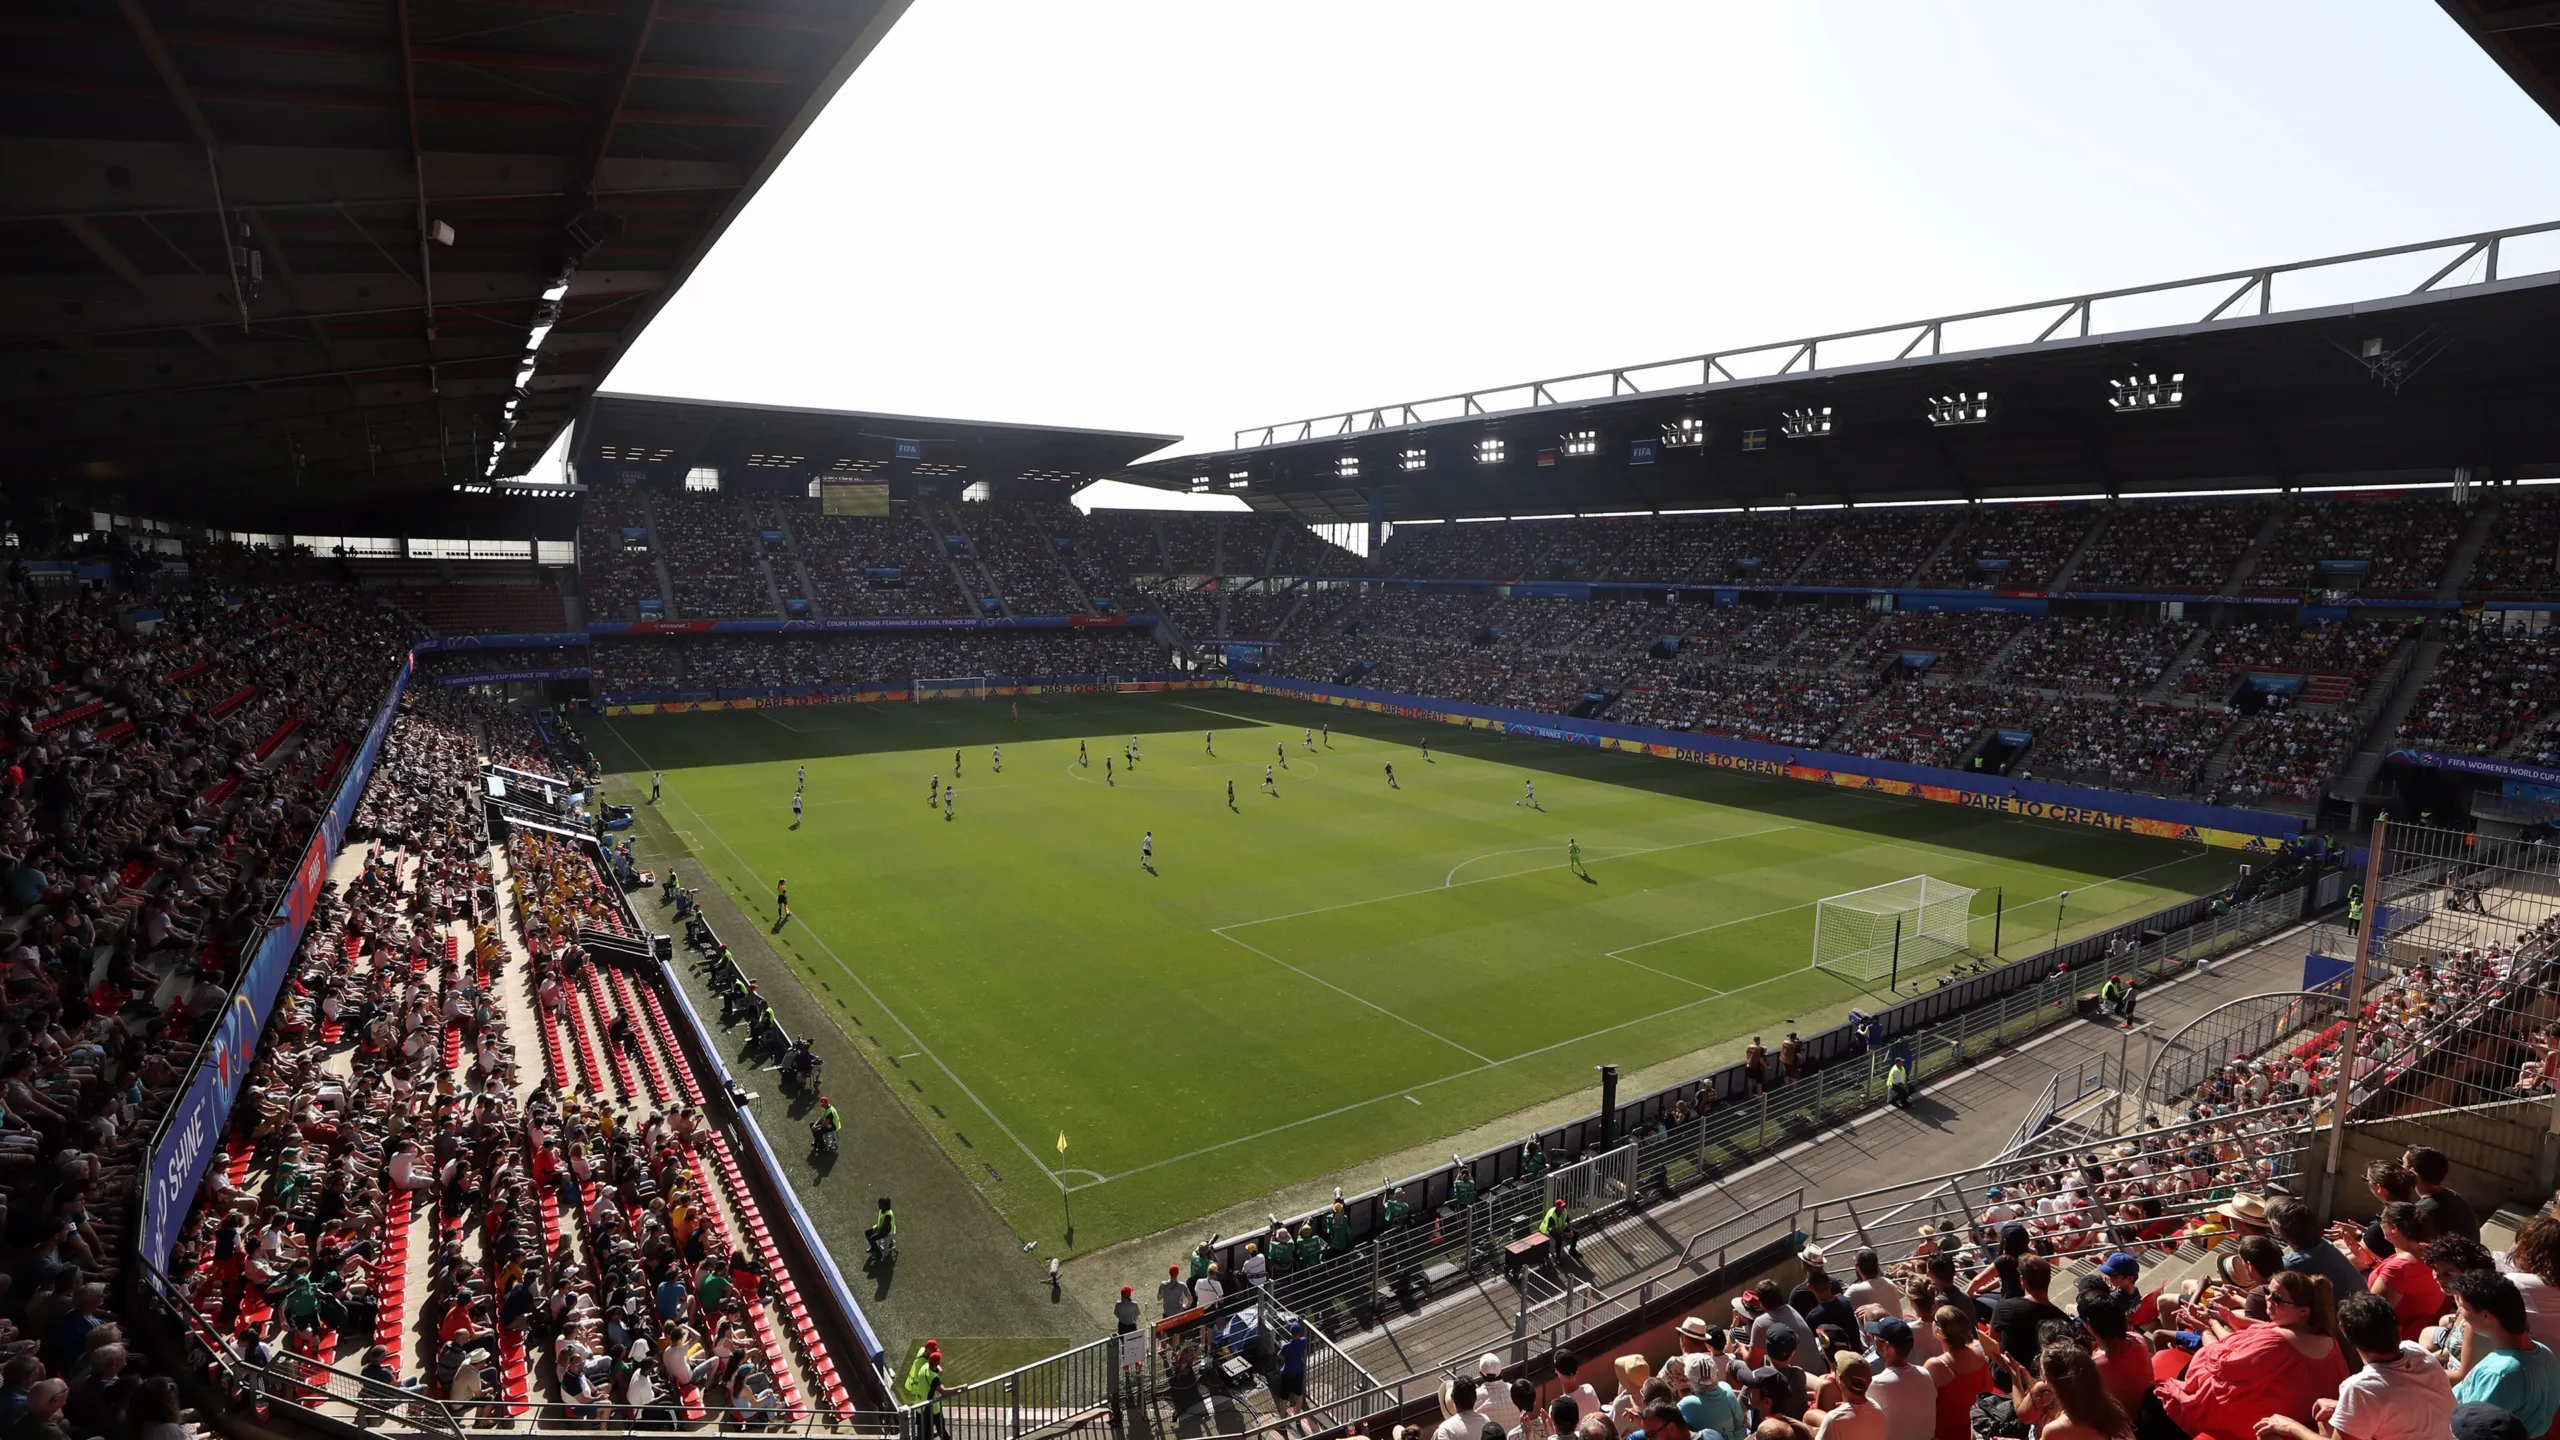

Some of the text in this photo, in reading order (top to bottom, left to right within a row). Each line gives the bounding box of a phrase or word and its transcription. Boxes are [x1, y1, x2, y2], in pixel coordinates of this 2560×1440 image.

[899, 444, 916, 453] FIFA
[1633, 447, 1651, 457] FIFA
[474, 674, 495, 683] WORLD
[496, 673, 509, 681] CUP
[510, 672, 534, 680] FRANCE
[1040, 682, 1121, 695] DARE TO CREATE
[755, 694, 858, 709] DARE TO CREATE
[1380, 703, 1448, 723] DARE TO CREATE
[1539, 729, 1561, 739] RENNES
[1676, 748, 1791, 777] DARE TO CREATE
[2448, 758, 2466, 768] FIFA
[2468, 761, 2508, 774] WOMEN'S
[2510, 766, 2539, 780] WORLD
[2540, 772, 2555, 782] CUP
[1959, 791, 2134, 833] DARE TO CREATE
